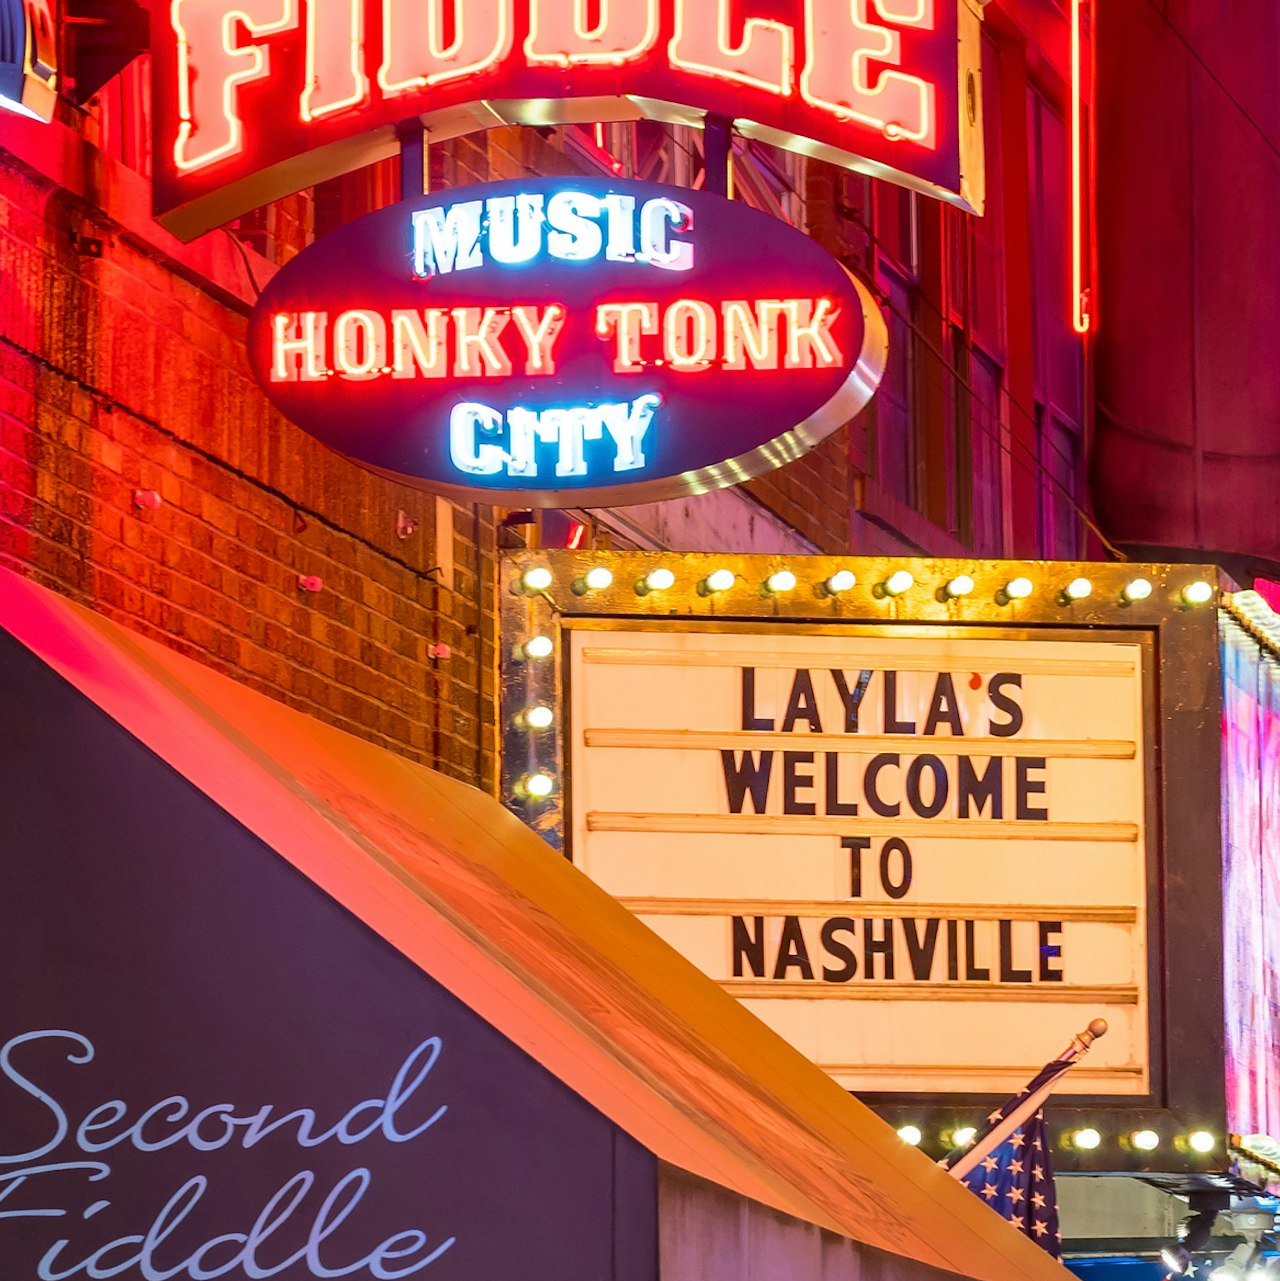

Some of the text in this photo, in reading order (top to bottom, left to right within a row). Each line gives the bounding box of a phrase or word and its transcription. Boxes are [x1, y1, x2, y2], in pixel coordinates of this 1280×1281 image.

[411, 188, 696, 280] MUSIC
[271, 297, 845, 382] HONKY TONK
[449, 394, 664, 478] CITY
[741, 667, 1024, 737] LAYLA'S
[721, 749, 1049, 821] WELCOME
[841, 836, 913, 900] TO
[732, 914, 1065, 983] NASHVILLE
